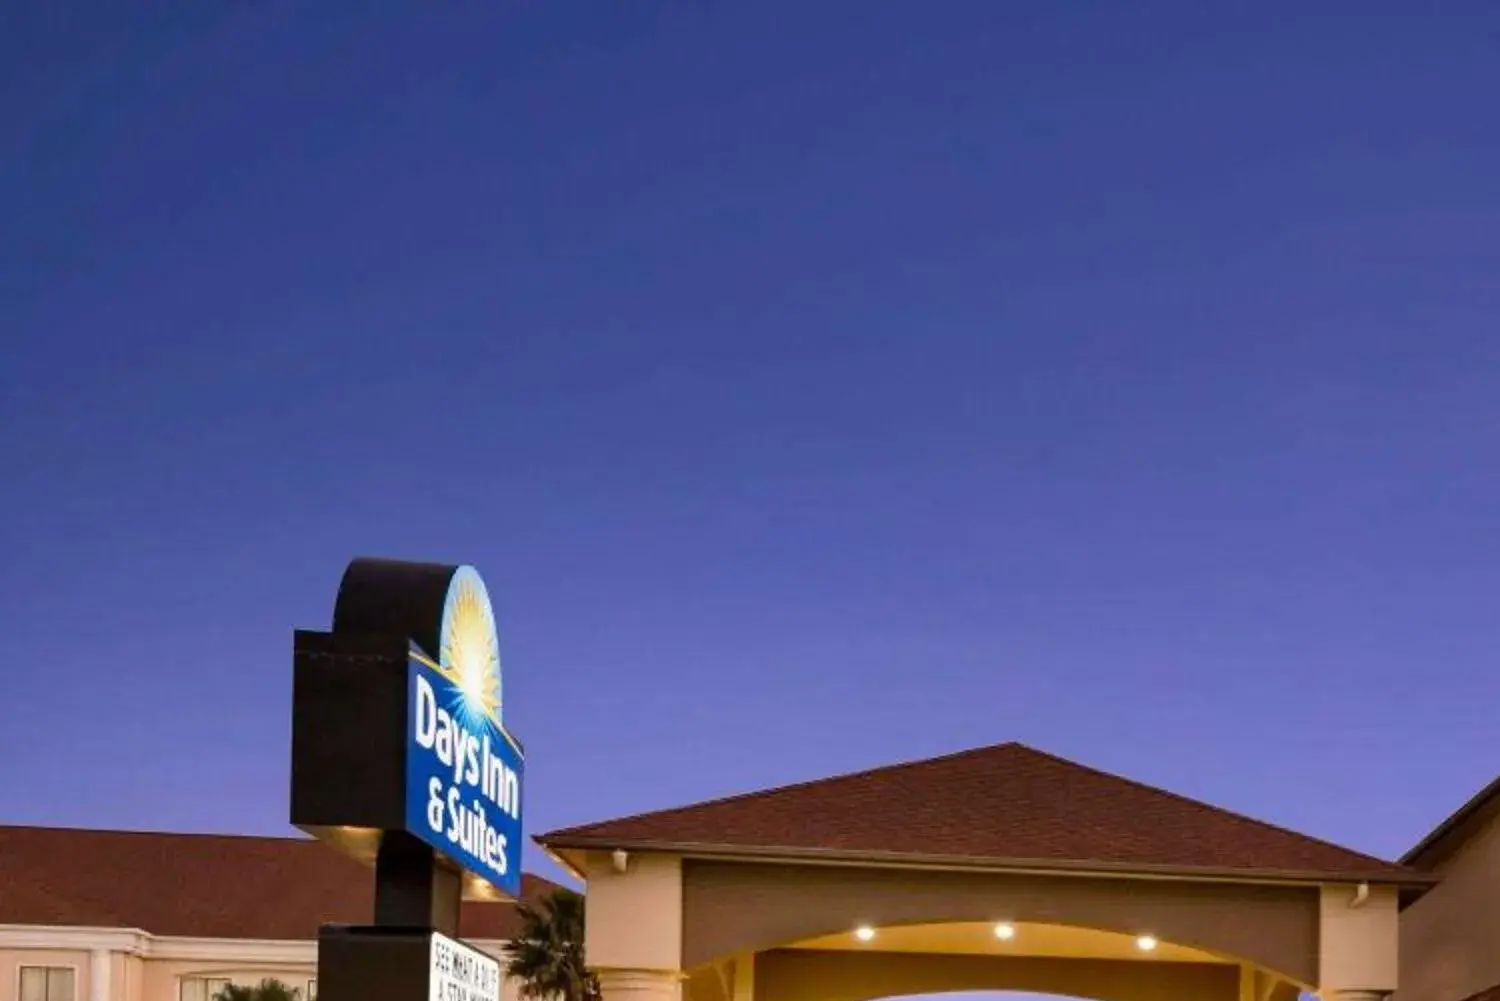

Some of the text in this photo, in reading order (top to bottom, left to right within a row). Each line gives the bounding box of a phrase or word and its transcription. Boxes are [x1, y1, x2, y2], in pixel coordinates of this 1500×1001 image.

[416, 674, 519, 821] Days Inn
[427, 776, 508, 876] & Suites
[435, 941, 450, 973] SEE
